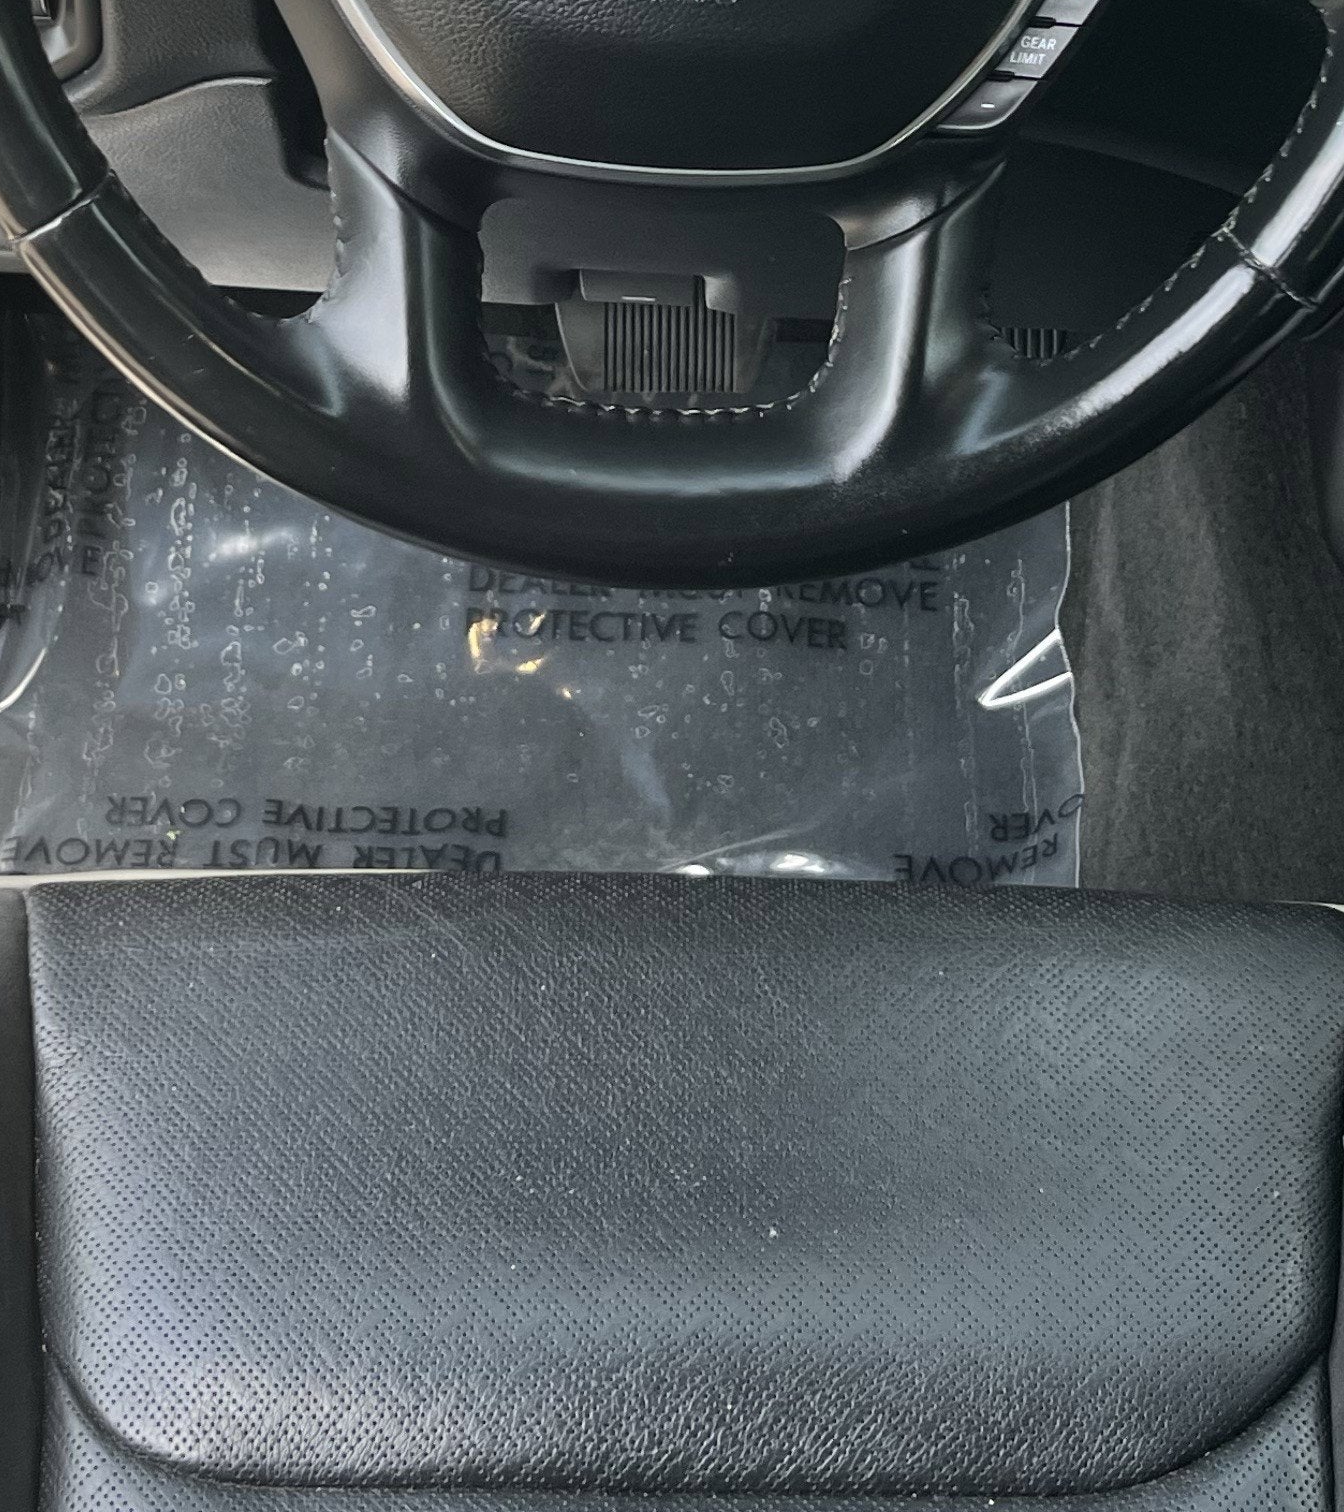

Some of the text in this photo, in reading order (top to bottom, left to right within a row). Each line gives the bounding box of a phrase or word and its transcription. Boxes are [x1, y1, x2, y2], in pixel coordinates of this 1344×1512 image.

[1009, 51, 1047, 66] LIMIT
[1020, 35, 1056, 52] GEAR
[466, 606, 848, 650] PROTECTIVE COVER
[105, 795, 508, 839] PROTECTIVE COVER
[0, 835, 176, 869] REMOVE
[203, 836, 324, 869] MUST
[892, 833, 1059, 888] REMOVE
